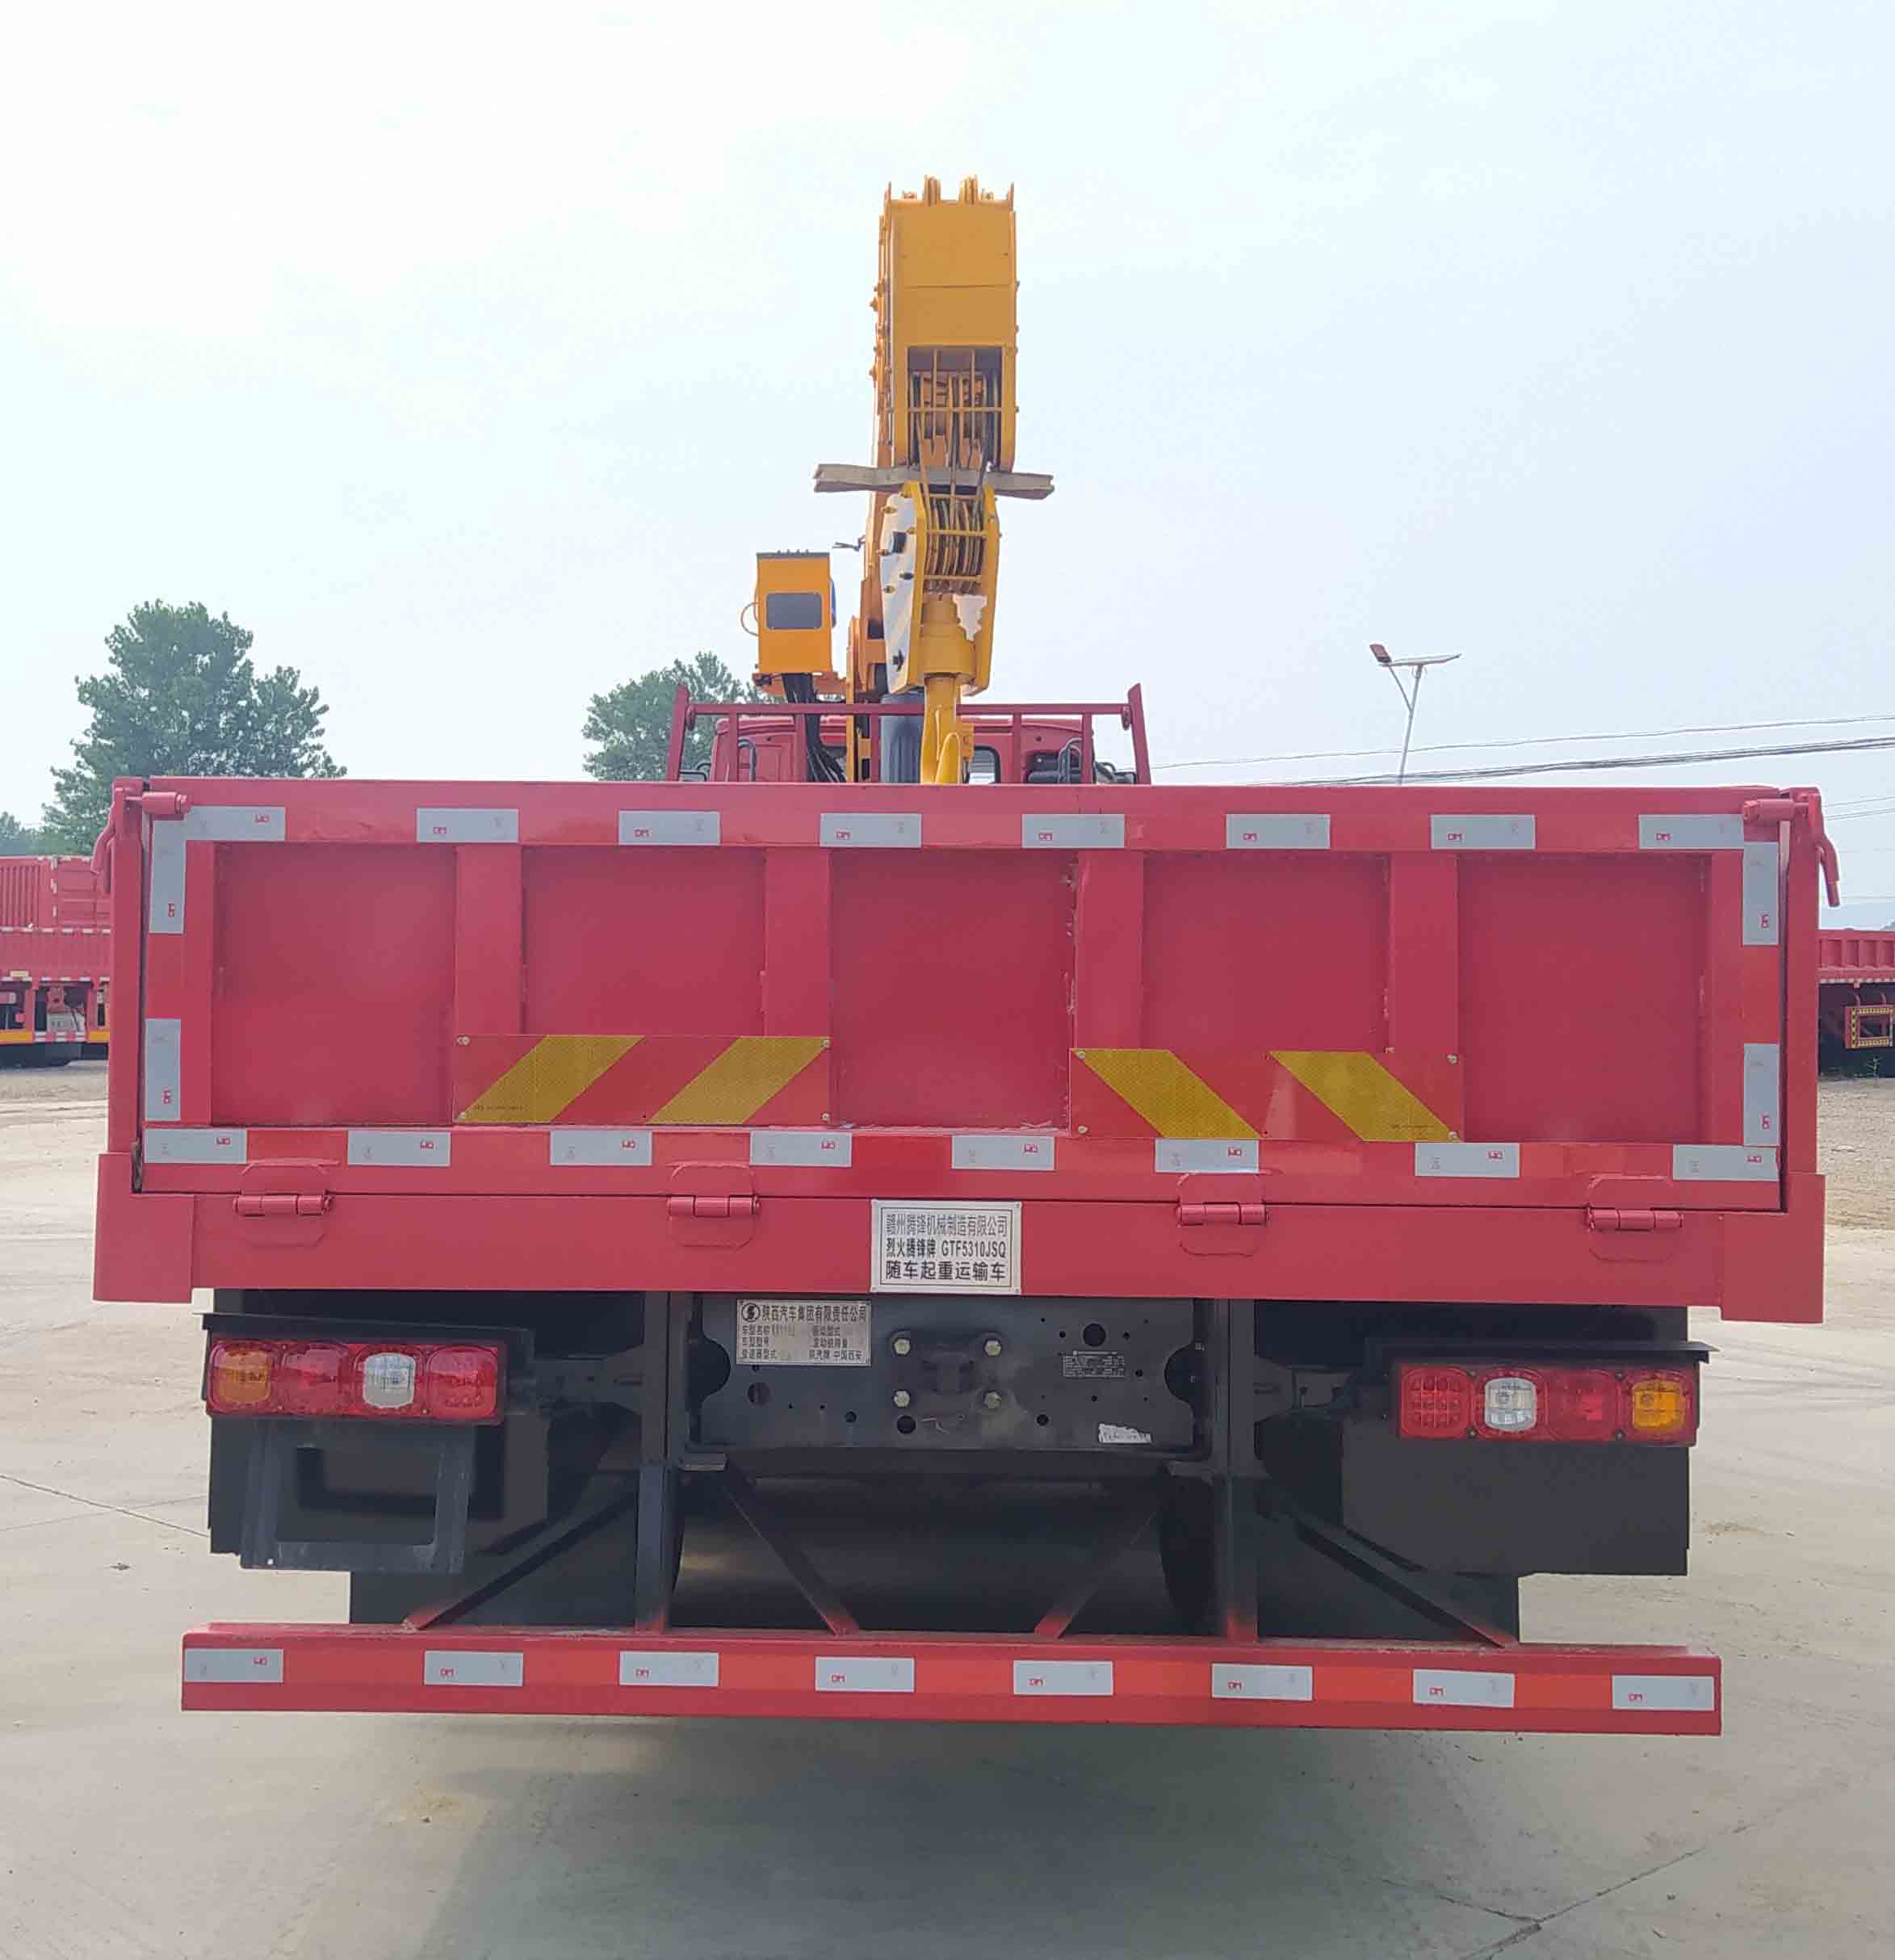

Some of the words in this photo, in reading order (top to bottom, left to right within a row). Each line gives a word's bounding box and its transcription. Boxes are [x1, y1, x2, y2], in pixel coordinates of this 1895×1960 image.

[941, 1240, 1006, 1258] GTF5310JSQ
[885, 1260, 1006, 1282] 随车起重运输车
[761, 1304, 866, 1322] 陕西汽车集团有限责任公司
